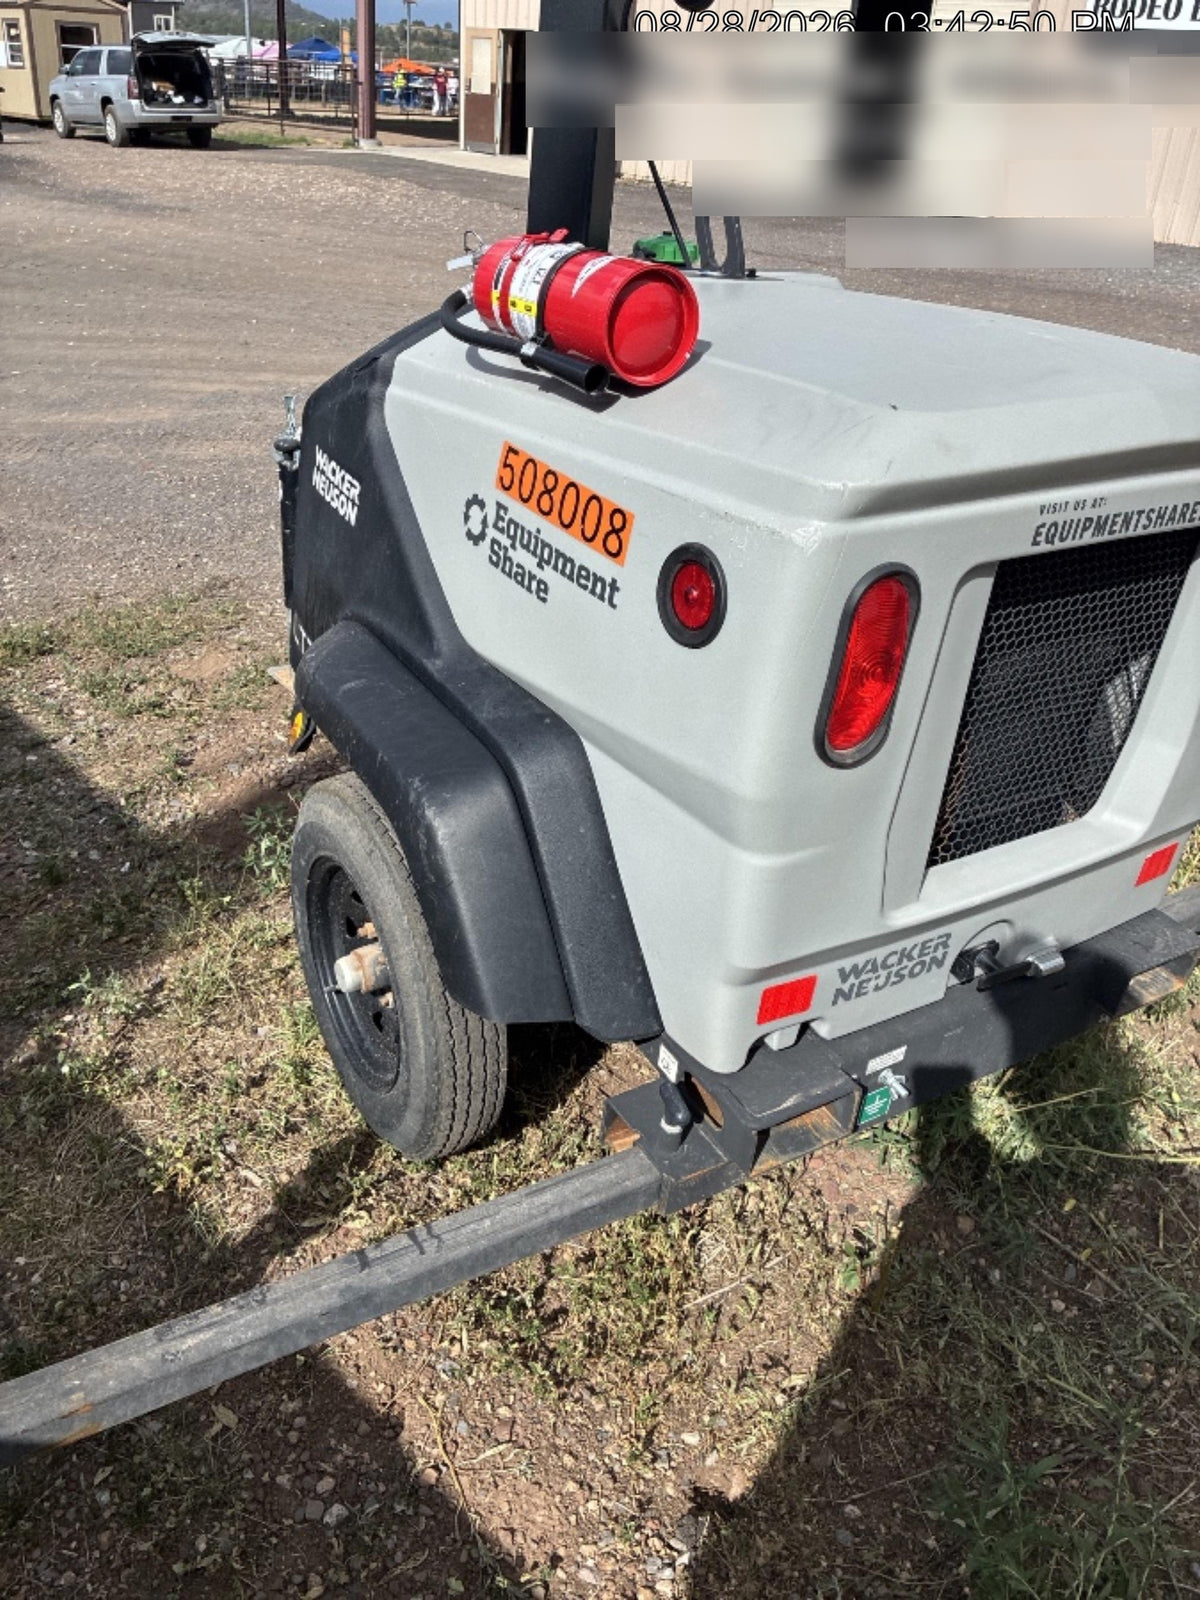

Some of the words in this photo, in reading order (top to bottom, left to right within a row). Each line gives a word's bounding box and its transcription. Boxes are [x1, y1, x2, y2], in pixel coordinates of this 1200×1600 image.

[312, 465, 358, 526] NEUSON
[315, 444, 361, 506] WACKER
[500, 446, 627, 559] 508008
[1040, 501, 1070, 515] VISIT
[1073, 499, 1087, 511] US
[488, 536, 550, 604] Share
[492, 500, 621, 610] Equipment
[831, 951, 948, 1007] NEUSON
[837, 933, 952, 984] WACKER
